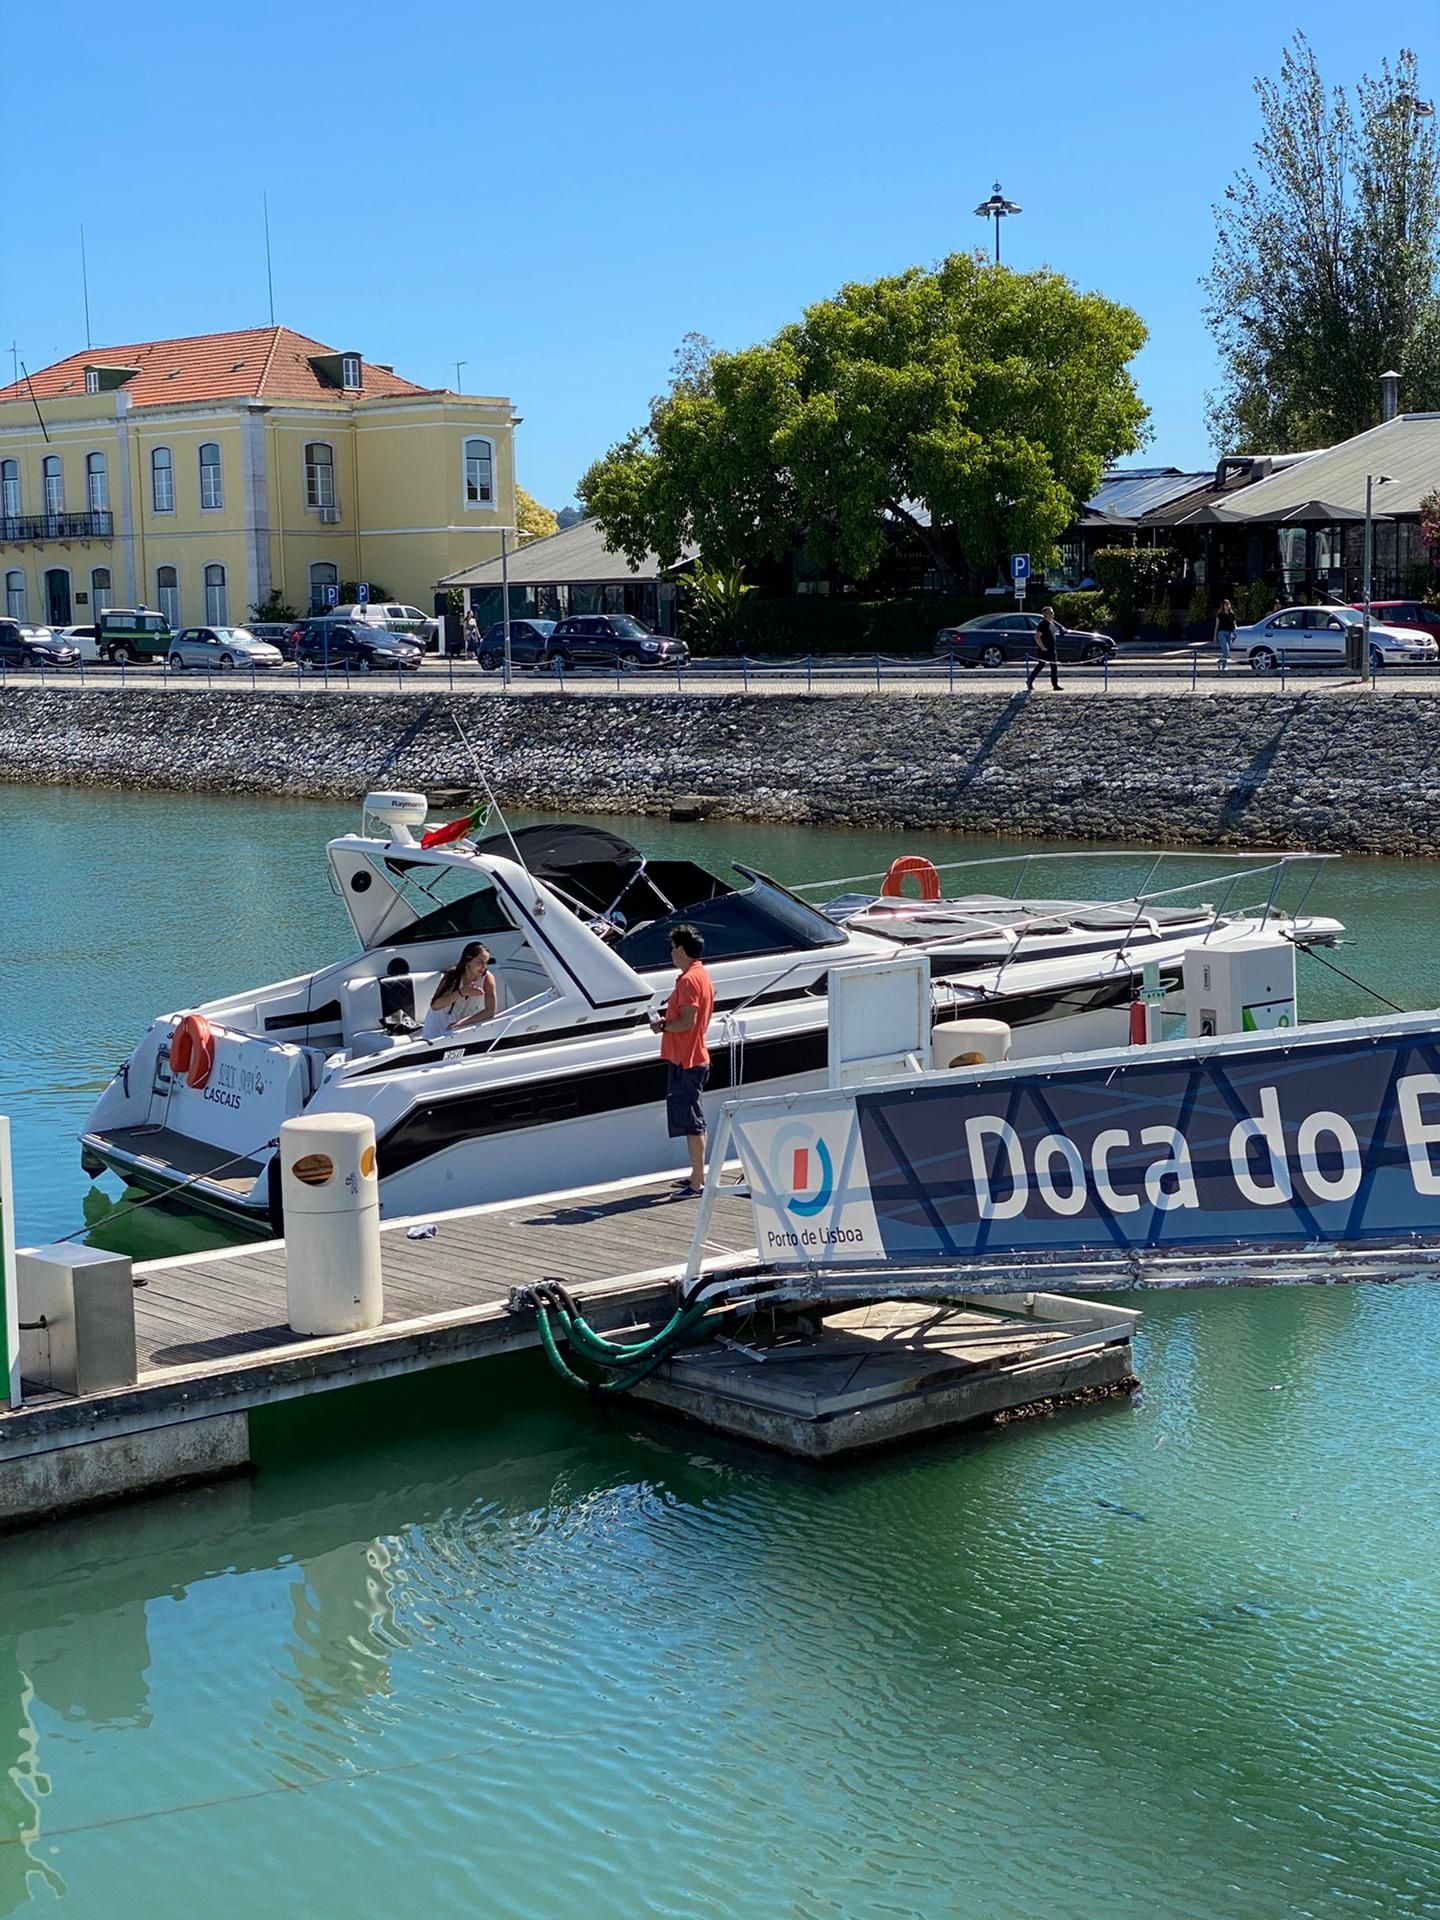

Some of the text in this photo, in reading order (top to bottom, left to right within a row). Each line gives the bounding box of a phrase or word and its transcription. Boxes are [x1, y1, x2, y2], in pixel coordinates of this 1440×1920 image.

[1015, 557, 1026, 576] P
[328, 588, 335, 603] P
[359, 585, 366, 600] P
[203, 1086, 242, 1110] CASCAIS
[965, 1116, 1200, 1220] Doca
[1229, 1087, 1362, 1206] do
[767, 1226, 864, 1248] Porto de Lisboa
